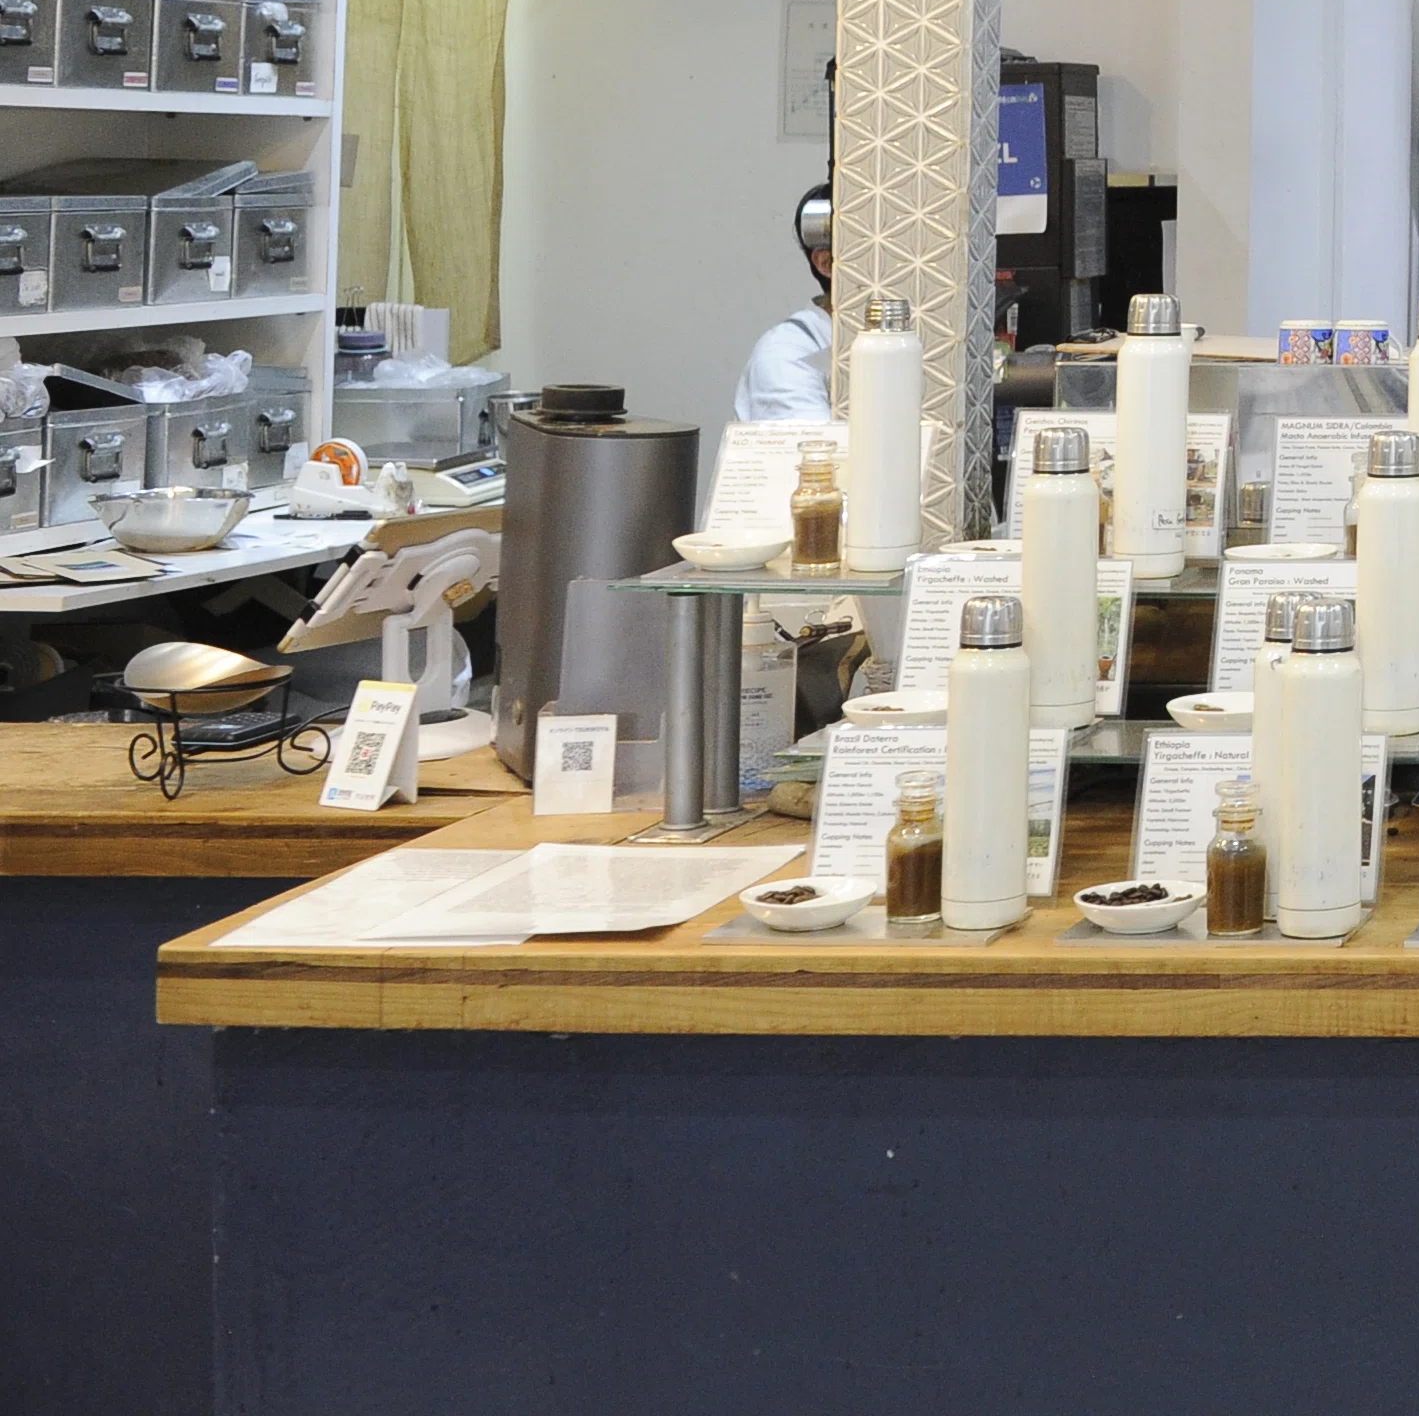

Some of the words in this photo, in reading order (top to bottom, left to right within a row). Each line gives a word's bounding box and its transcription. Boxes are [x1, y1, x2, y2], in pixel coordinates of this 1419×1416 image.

[973, 575, 1008, 583] Washed
[1293, 577, 1329, 585] Washed
[370, 700, 401, 715] PayPay
[834, 735, 860, 743] Brazil
[833, 745, 878, 754] Rainforest
[881, 745, 936, 754] Certification
[1154, 741, 1190, 750] Ethiopia
[1154, 751, 1206, 761] Yirgacheffe
[1214, 751, 1250, 760] Natural
[1150, 777, 1178, 785] General
[1144, 839, 1173, 848] Cupping
[1176, 839, 1195, 847] Notes
